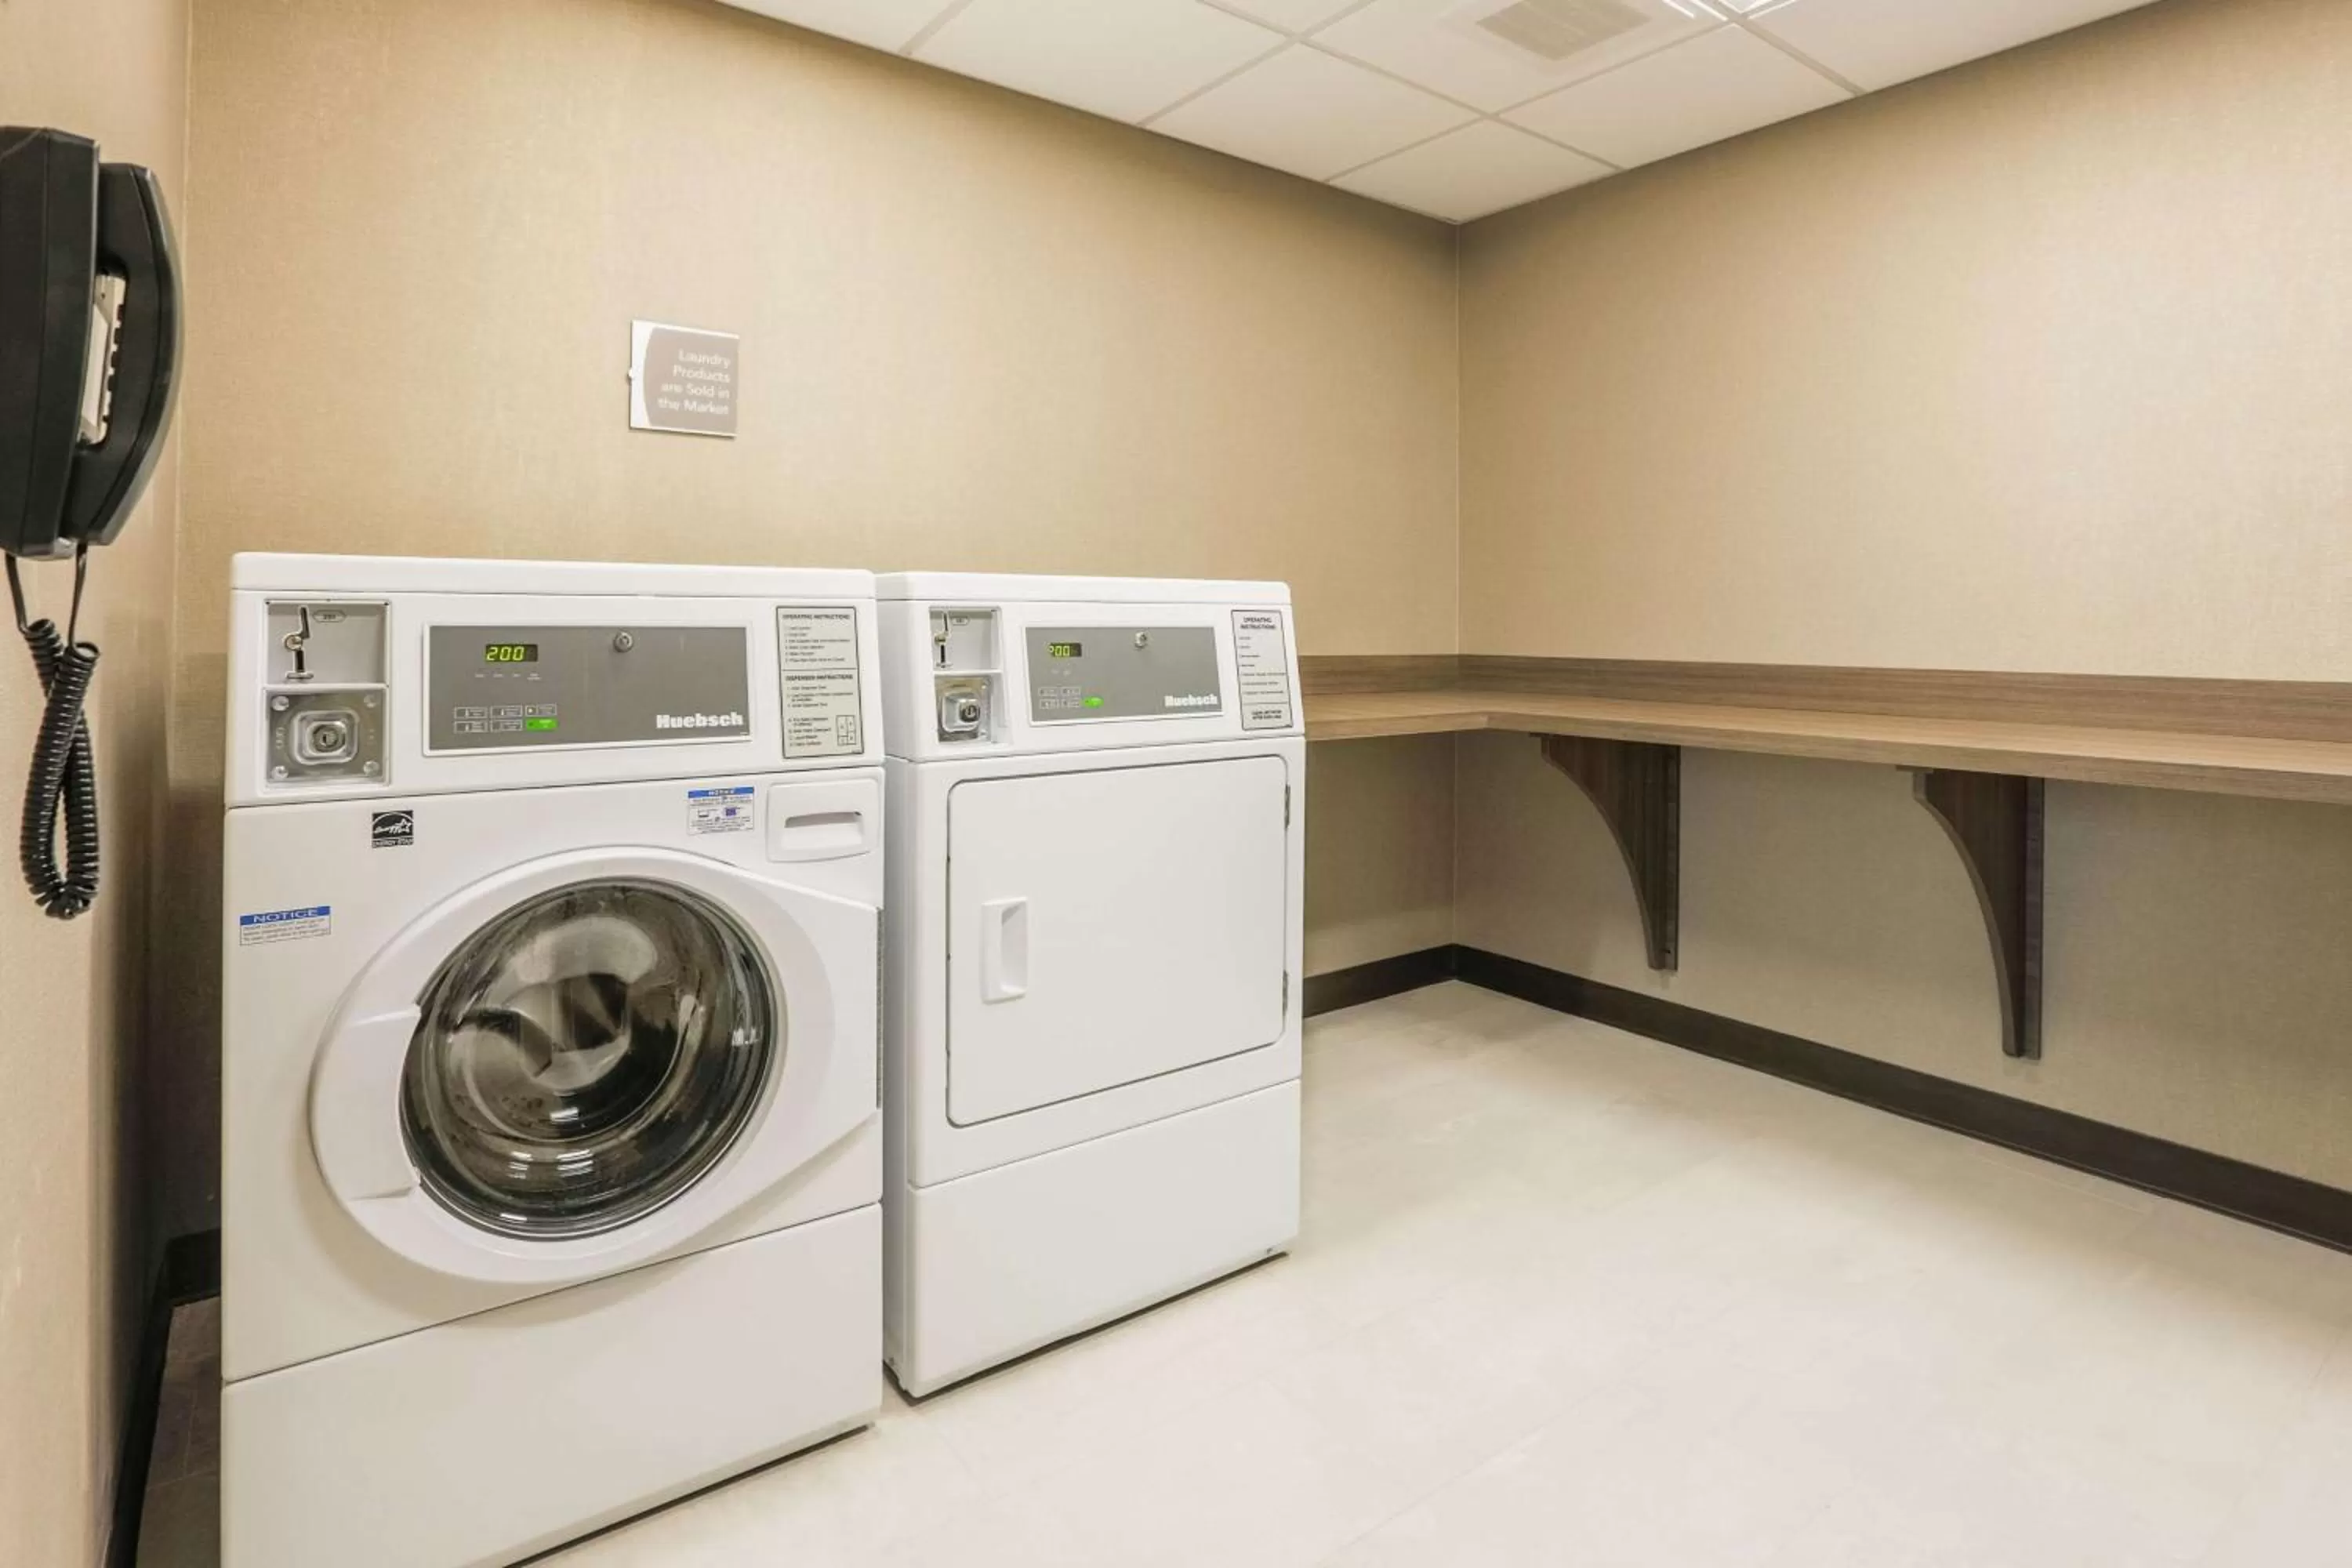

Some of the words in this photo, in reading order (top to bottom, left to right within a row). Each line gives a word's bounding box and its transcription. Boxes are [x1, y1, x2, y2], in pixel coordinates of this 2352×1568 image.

[678, 348, 731, 368] Laundry
[673, 365, 731, 383] Products
[661, 383, 684, 393] are
[687, 383, 715, 397] Sold
[717, 386, 730, 398] in
[658, 397, 680, 411] the
[683, 399, 729, 415] Market
[487, 646, 524, 661] 200
[1164, 693, 1218, 707] Huebsch
[656, 711, 743, 728] Huebsch
[253, 909, 318, 923] NOTICE
